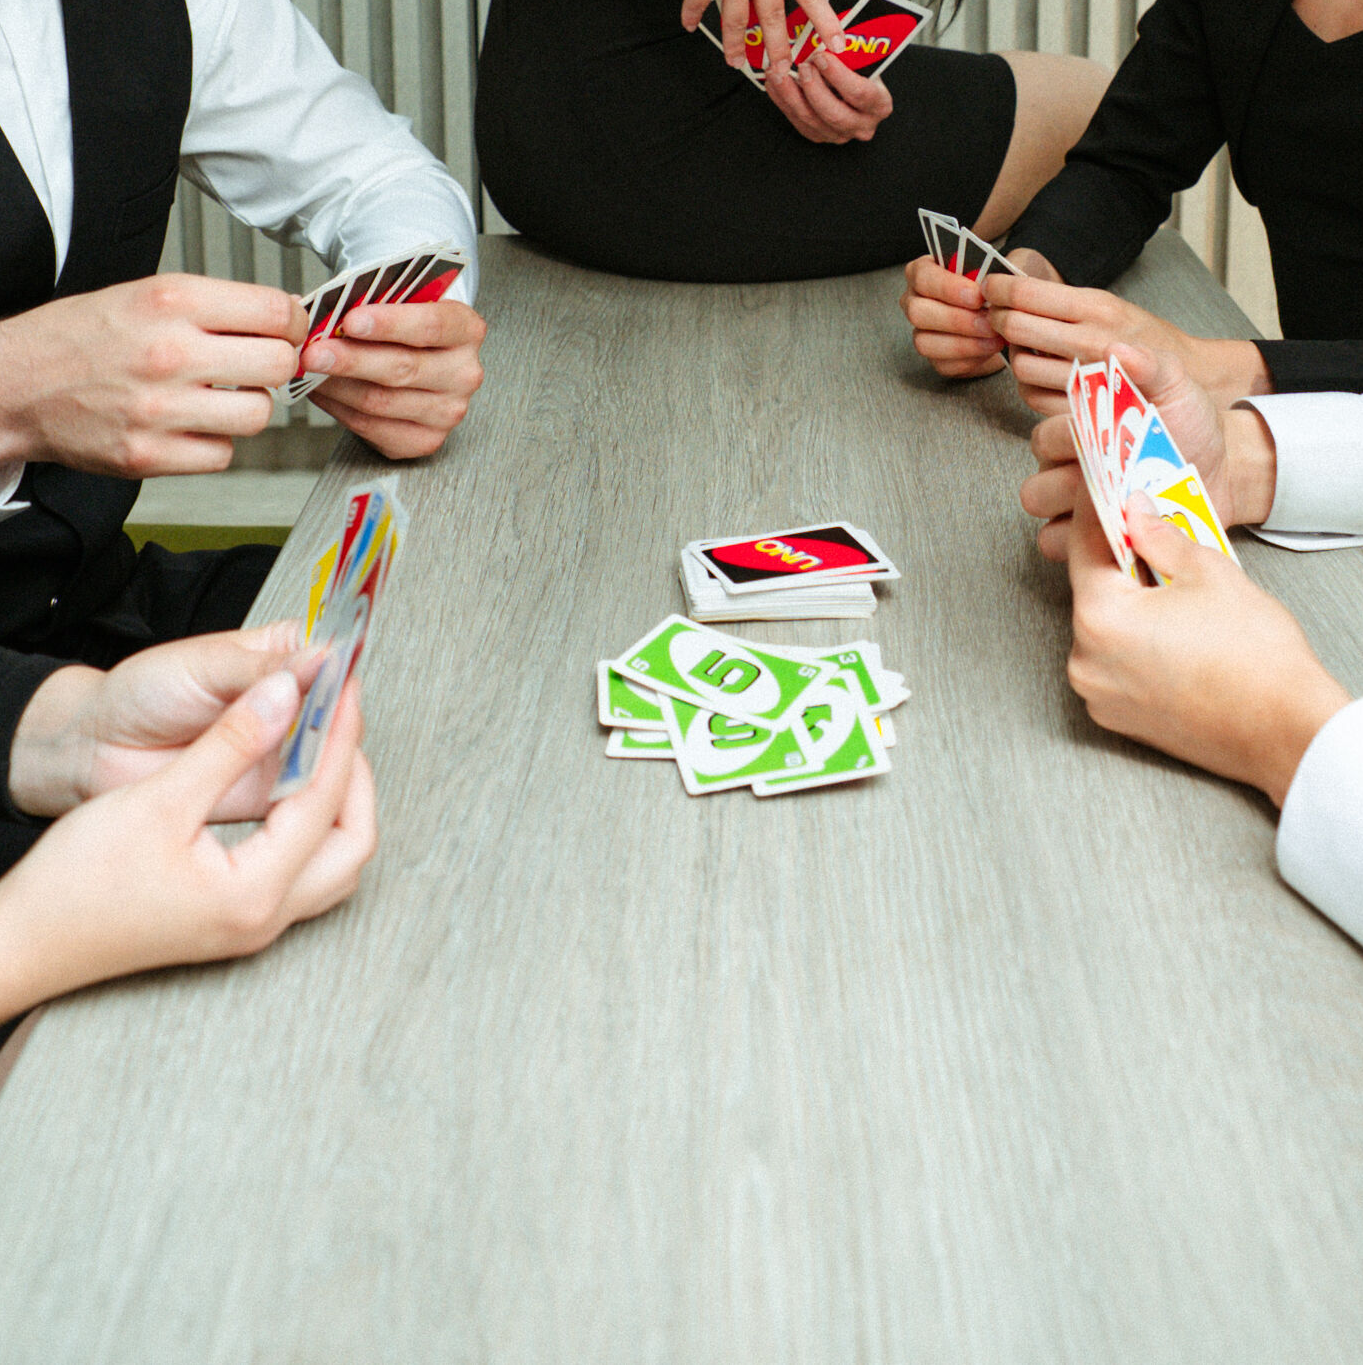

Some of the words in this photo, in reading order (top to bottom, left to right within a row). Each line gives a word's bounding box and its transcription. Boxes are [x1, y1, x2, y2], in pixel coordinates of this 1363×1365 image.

[754, 539, 823, 571] UNO
[629, 657, 650, 674] 5
[838, 651, 857, 665] 3
[688, 649, 762, 694] 5
[797, 665, 817, 679] 5
